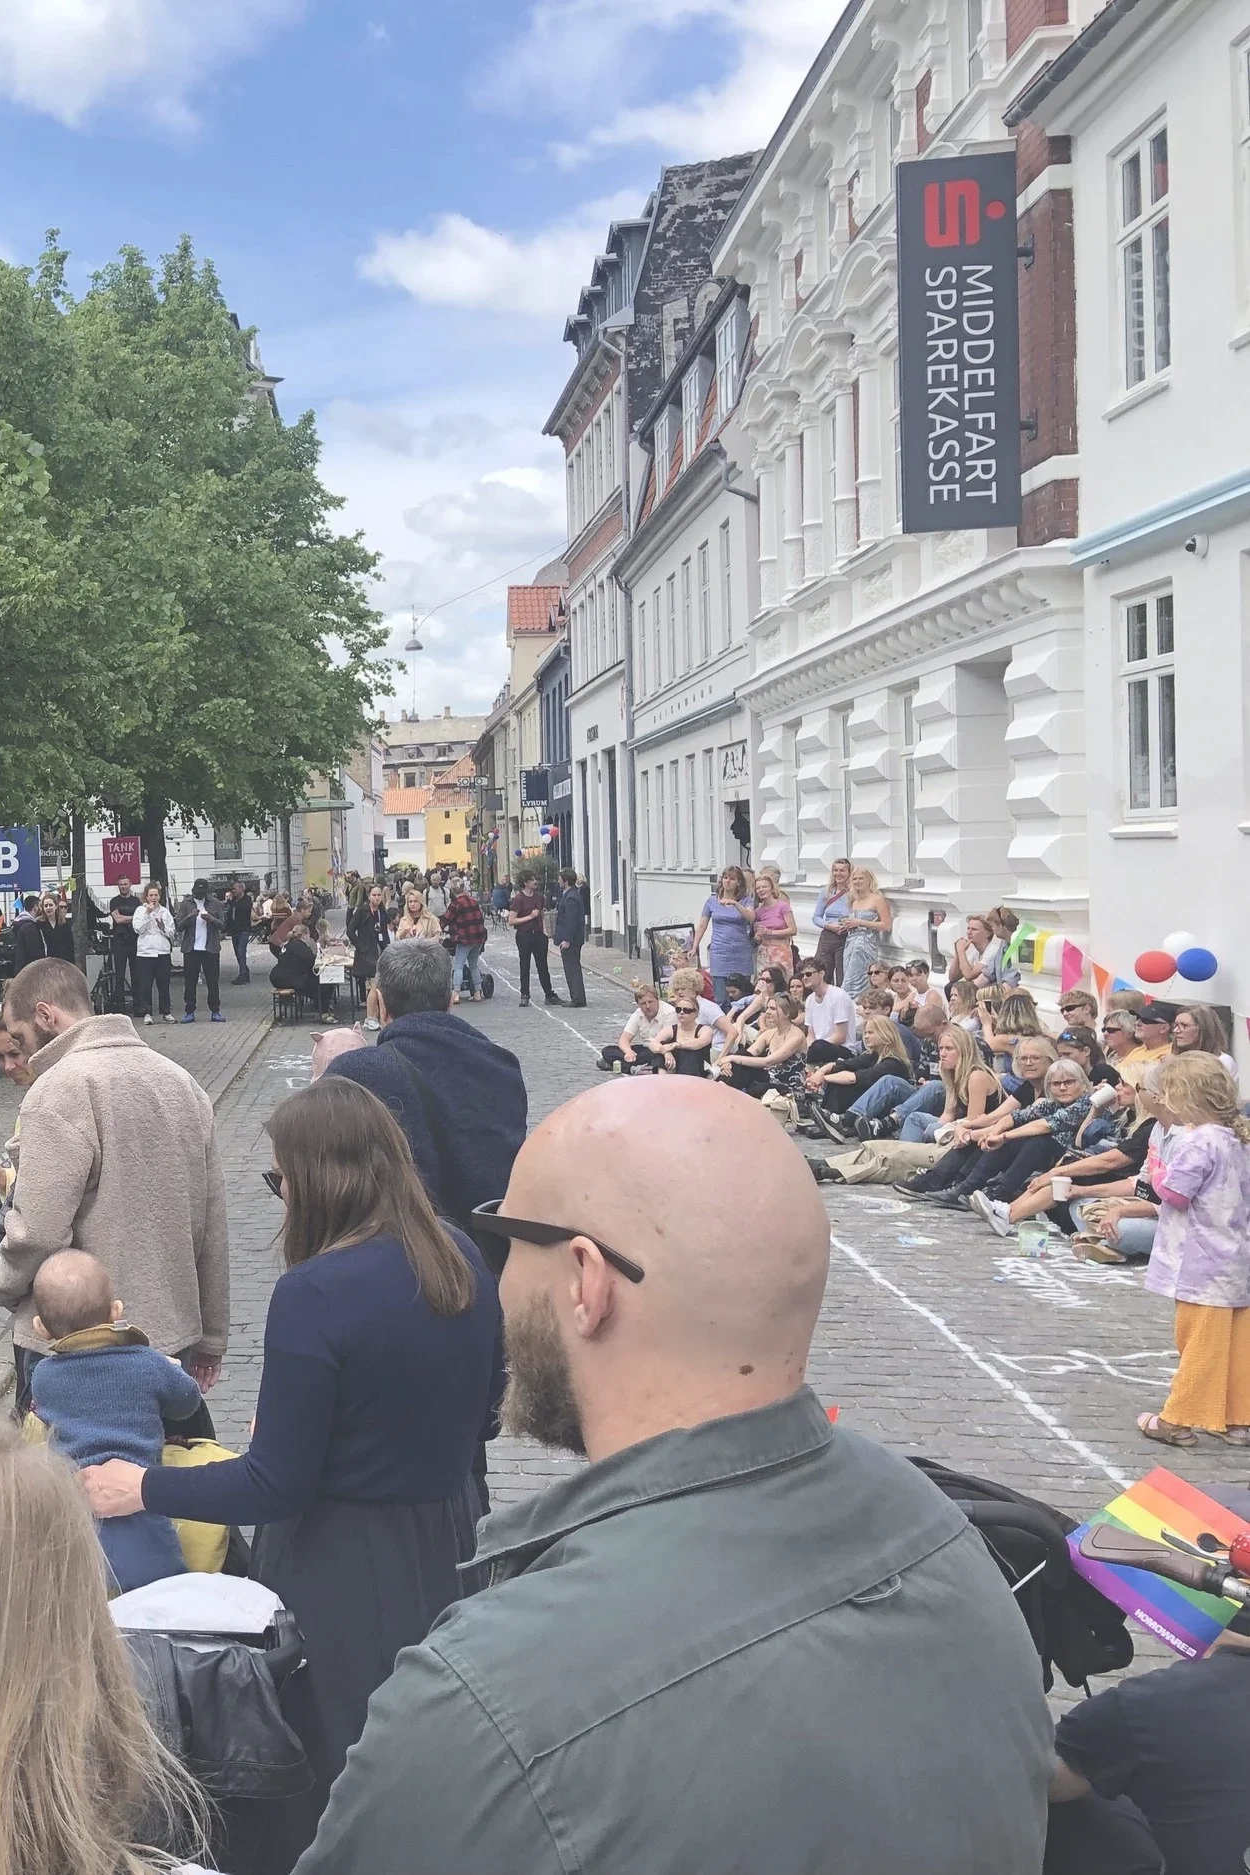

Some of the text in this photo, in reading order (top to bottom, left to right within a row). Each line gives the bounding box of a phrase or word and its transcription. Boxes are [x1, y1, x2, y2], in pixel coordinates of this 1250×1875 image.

[925, 266, 961, 505] SPAREKASSE
[962, 264, 997, 504] MIDDELFART
[521, 799, 548, 807] LYRUM
[107, 842, 135, 852] TÆNK
[110, 852, 132, 864] NYT
[1134, 1608, 1189, 1653] HOMOWARE
